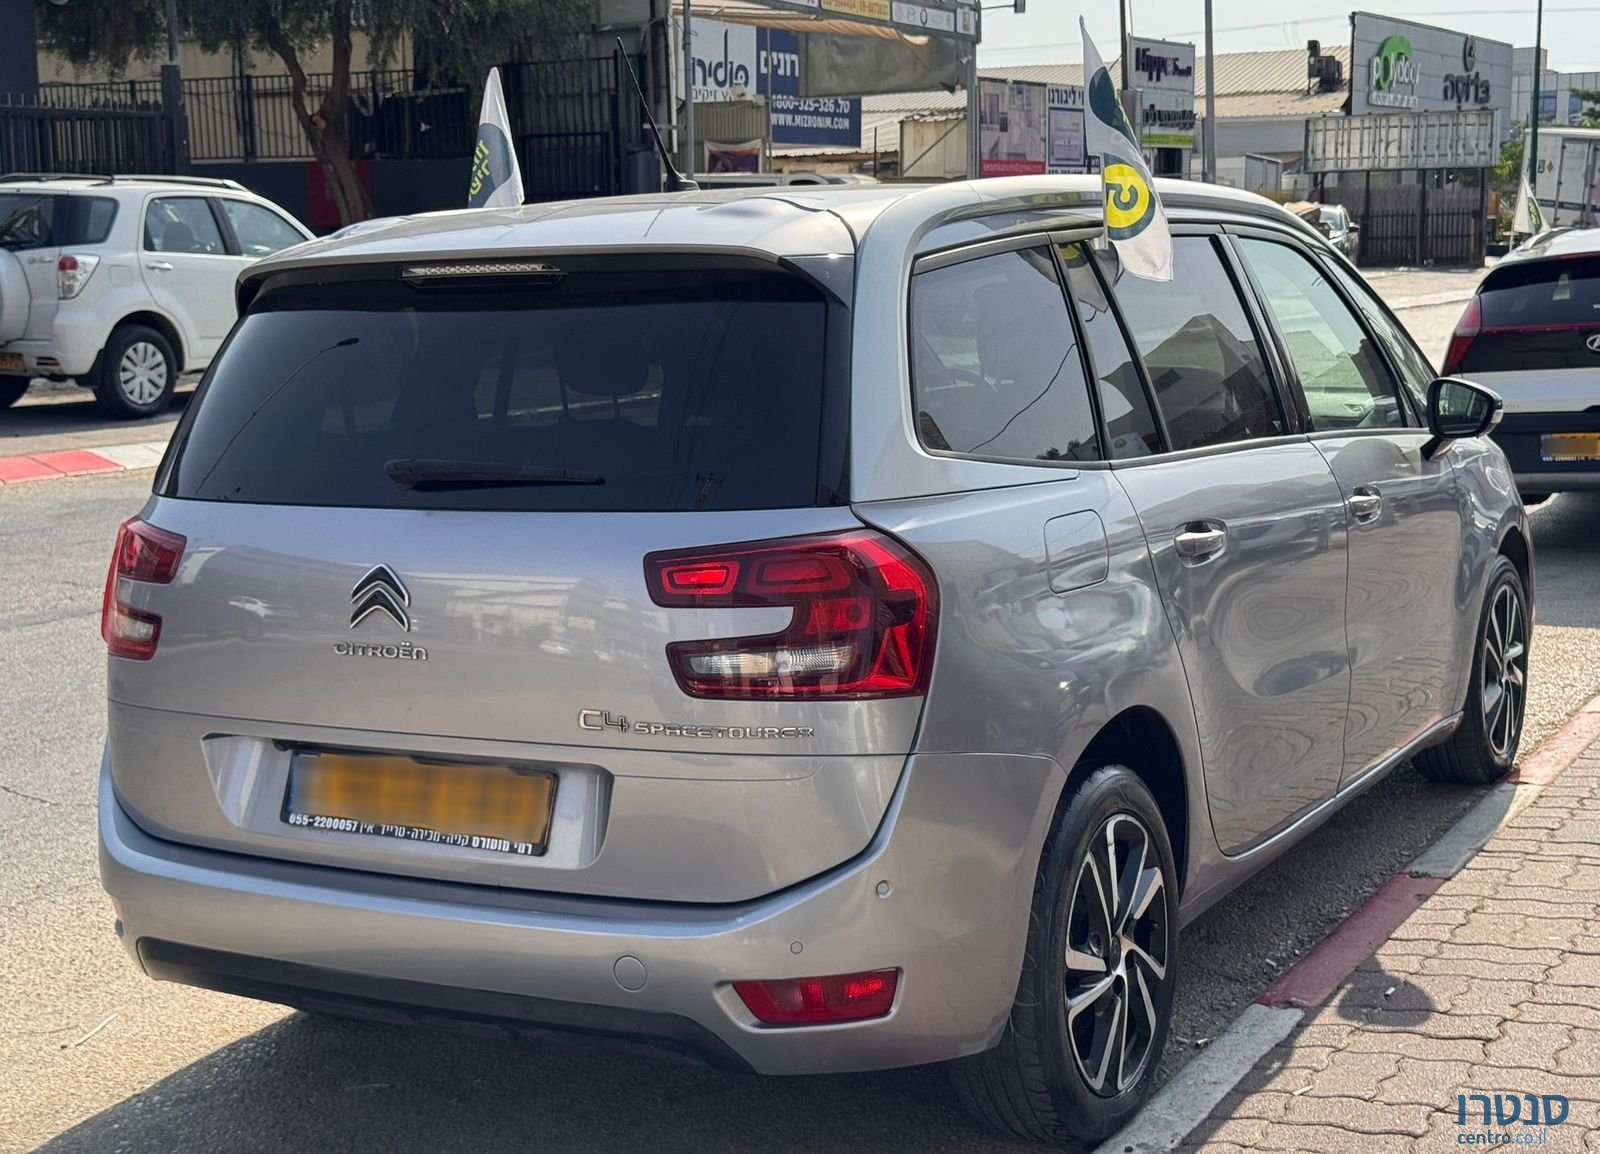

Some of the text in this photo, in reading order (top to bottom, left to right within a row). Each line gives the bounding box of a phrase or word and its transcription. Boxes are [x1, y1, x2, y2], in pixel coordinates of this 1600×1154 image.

[691, 28, 749, 88] פולירו
[760, 50, 799, 78] רונים
[769, 113, 850, 130] WWW.MIZRONIM.COM
[578, 709, 815, 739] C4 SPACETOURER
[288, 813, 358, 832] 055-2200057
[471, 836, 511, 852] מוטורס
[513, 843, 533, 855] רמי
